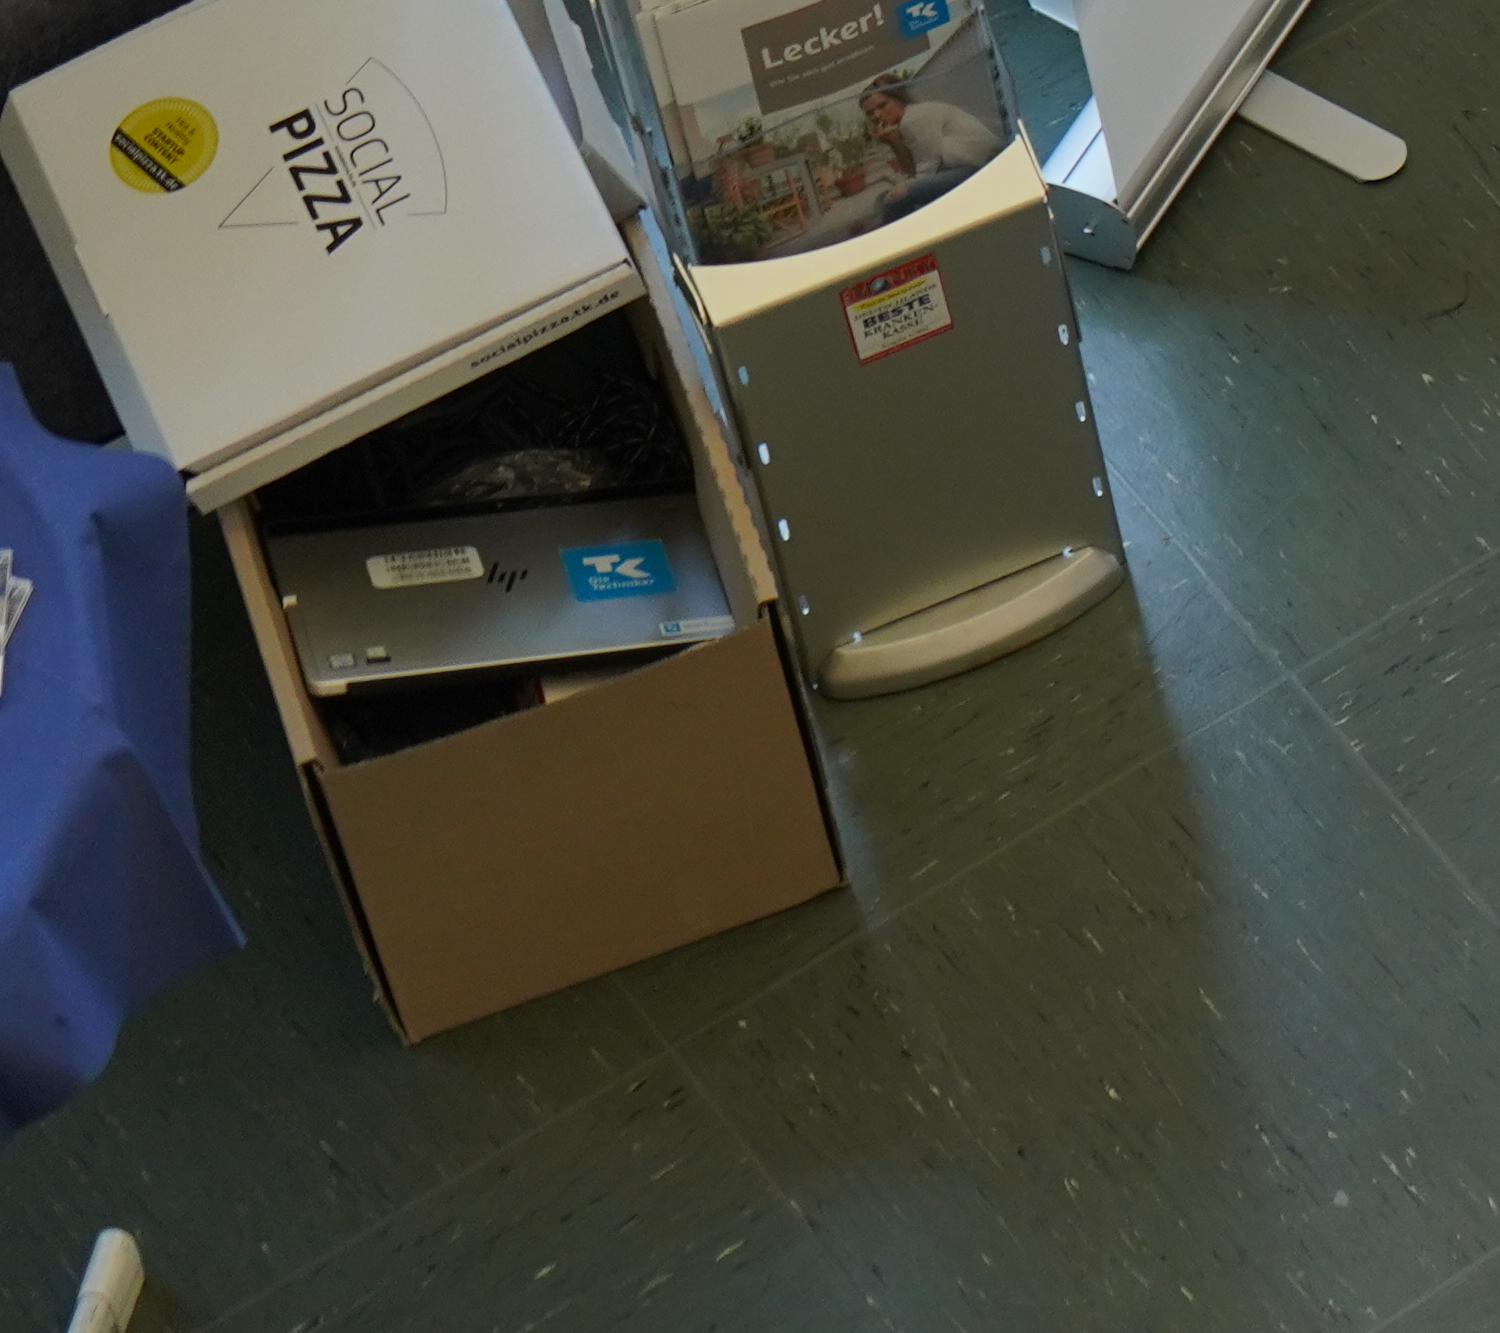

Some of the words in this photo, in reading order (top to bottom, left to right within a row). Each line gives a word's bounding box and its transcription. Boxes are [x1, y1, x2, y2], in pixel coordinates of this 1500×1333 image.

[760, 3, 885, 70] Lecker!
[269, 108, 363, 255] PIZZA
[324, 87, 411, 226] SOCIAL
[469, 288, 620, 370] socialpizza.tk.de
[863, 293, 931, 329] BESTE
